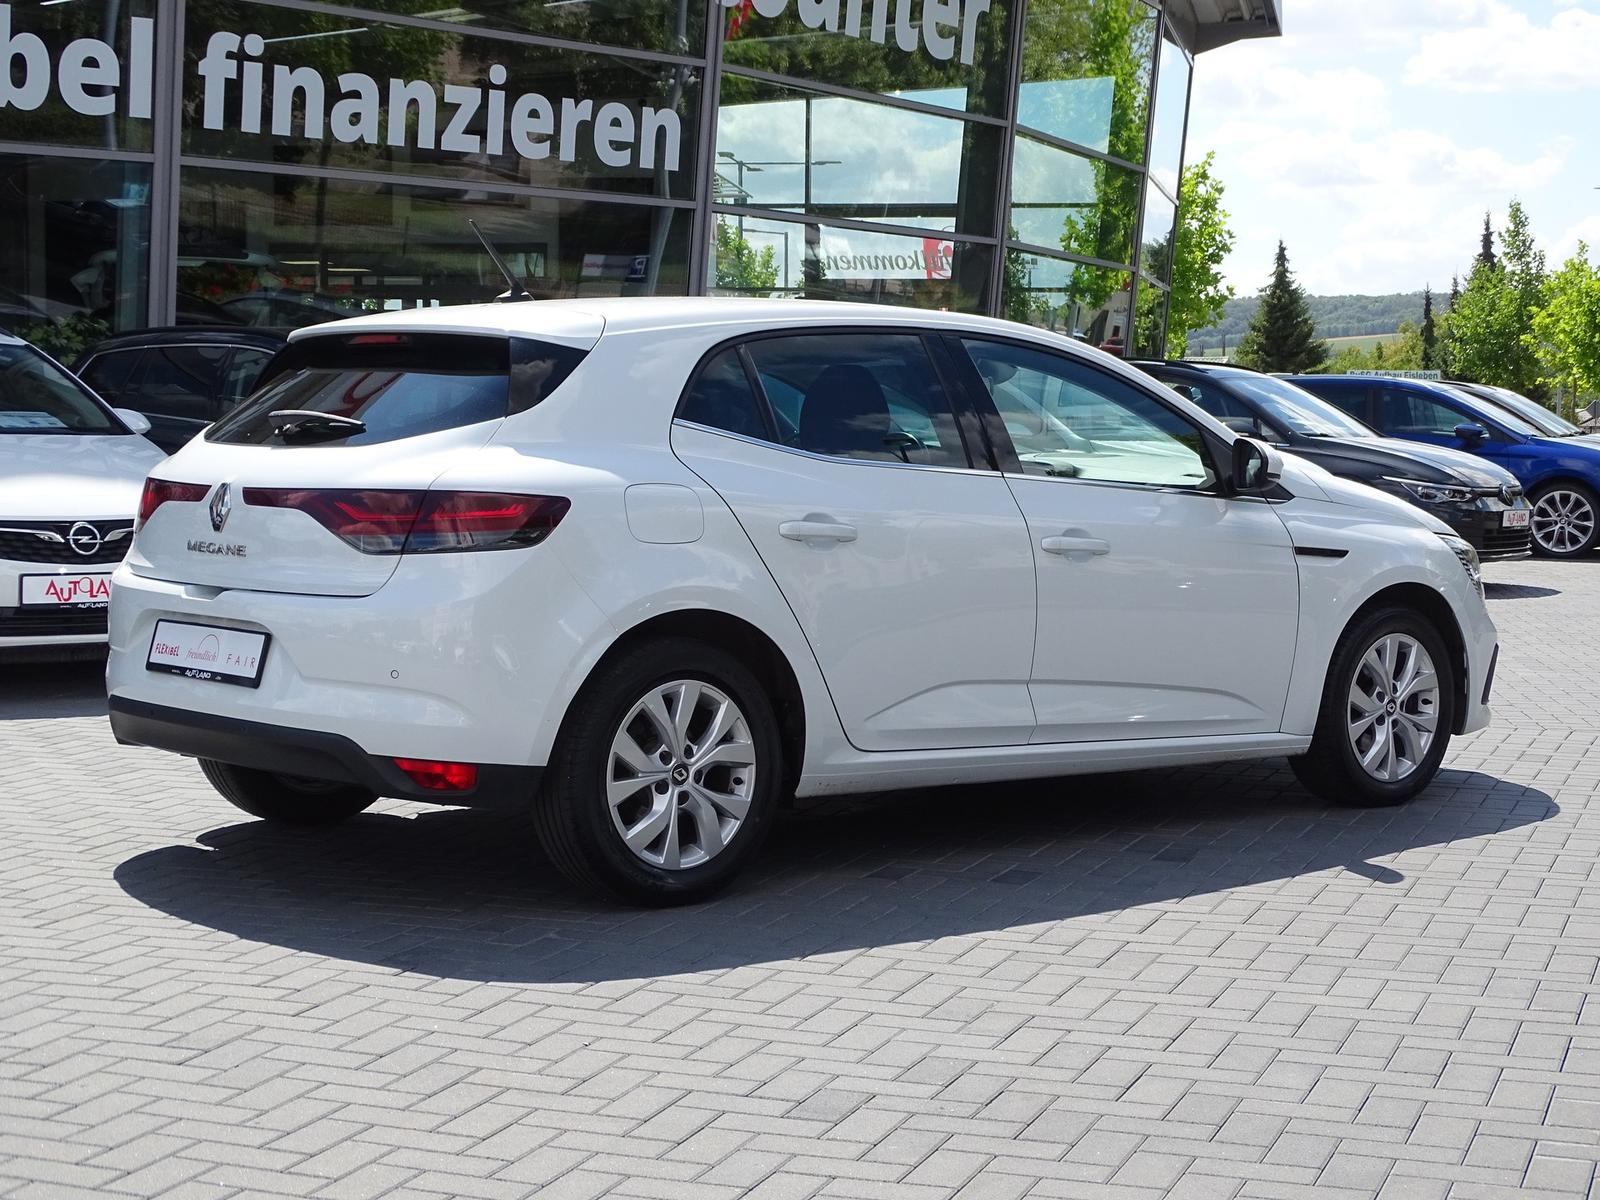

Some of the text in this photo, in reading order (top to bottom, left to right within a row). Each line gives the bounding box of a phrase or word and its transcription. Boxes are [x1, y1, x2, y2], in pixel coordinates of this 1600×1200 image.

[198, 31, 682, 172] finanzieren
[1404, 371, 1438, 380] Eisleben
[187, 540, 247, 557] MEGANE
[46, 576, 112, 602] AUTOLA
